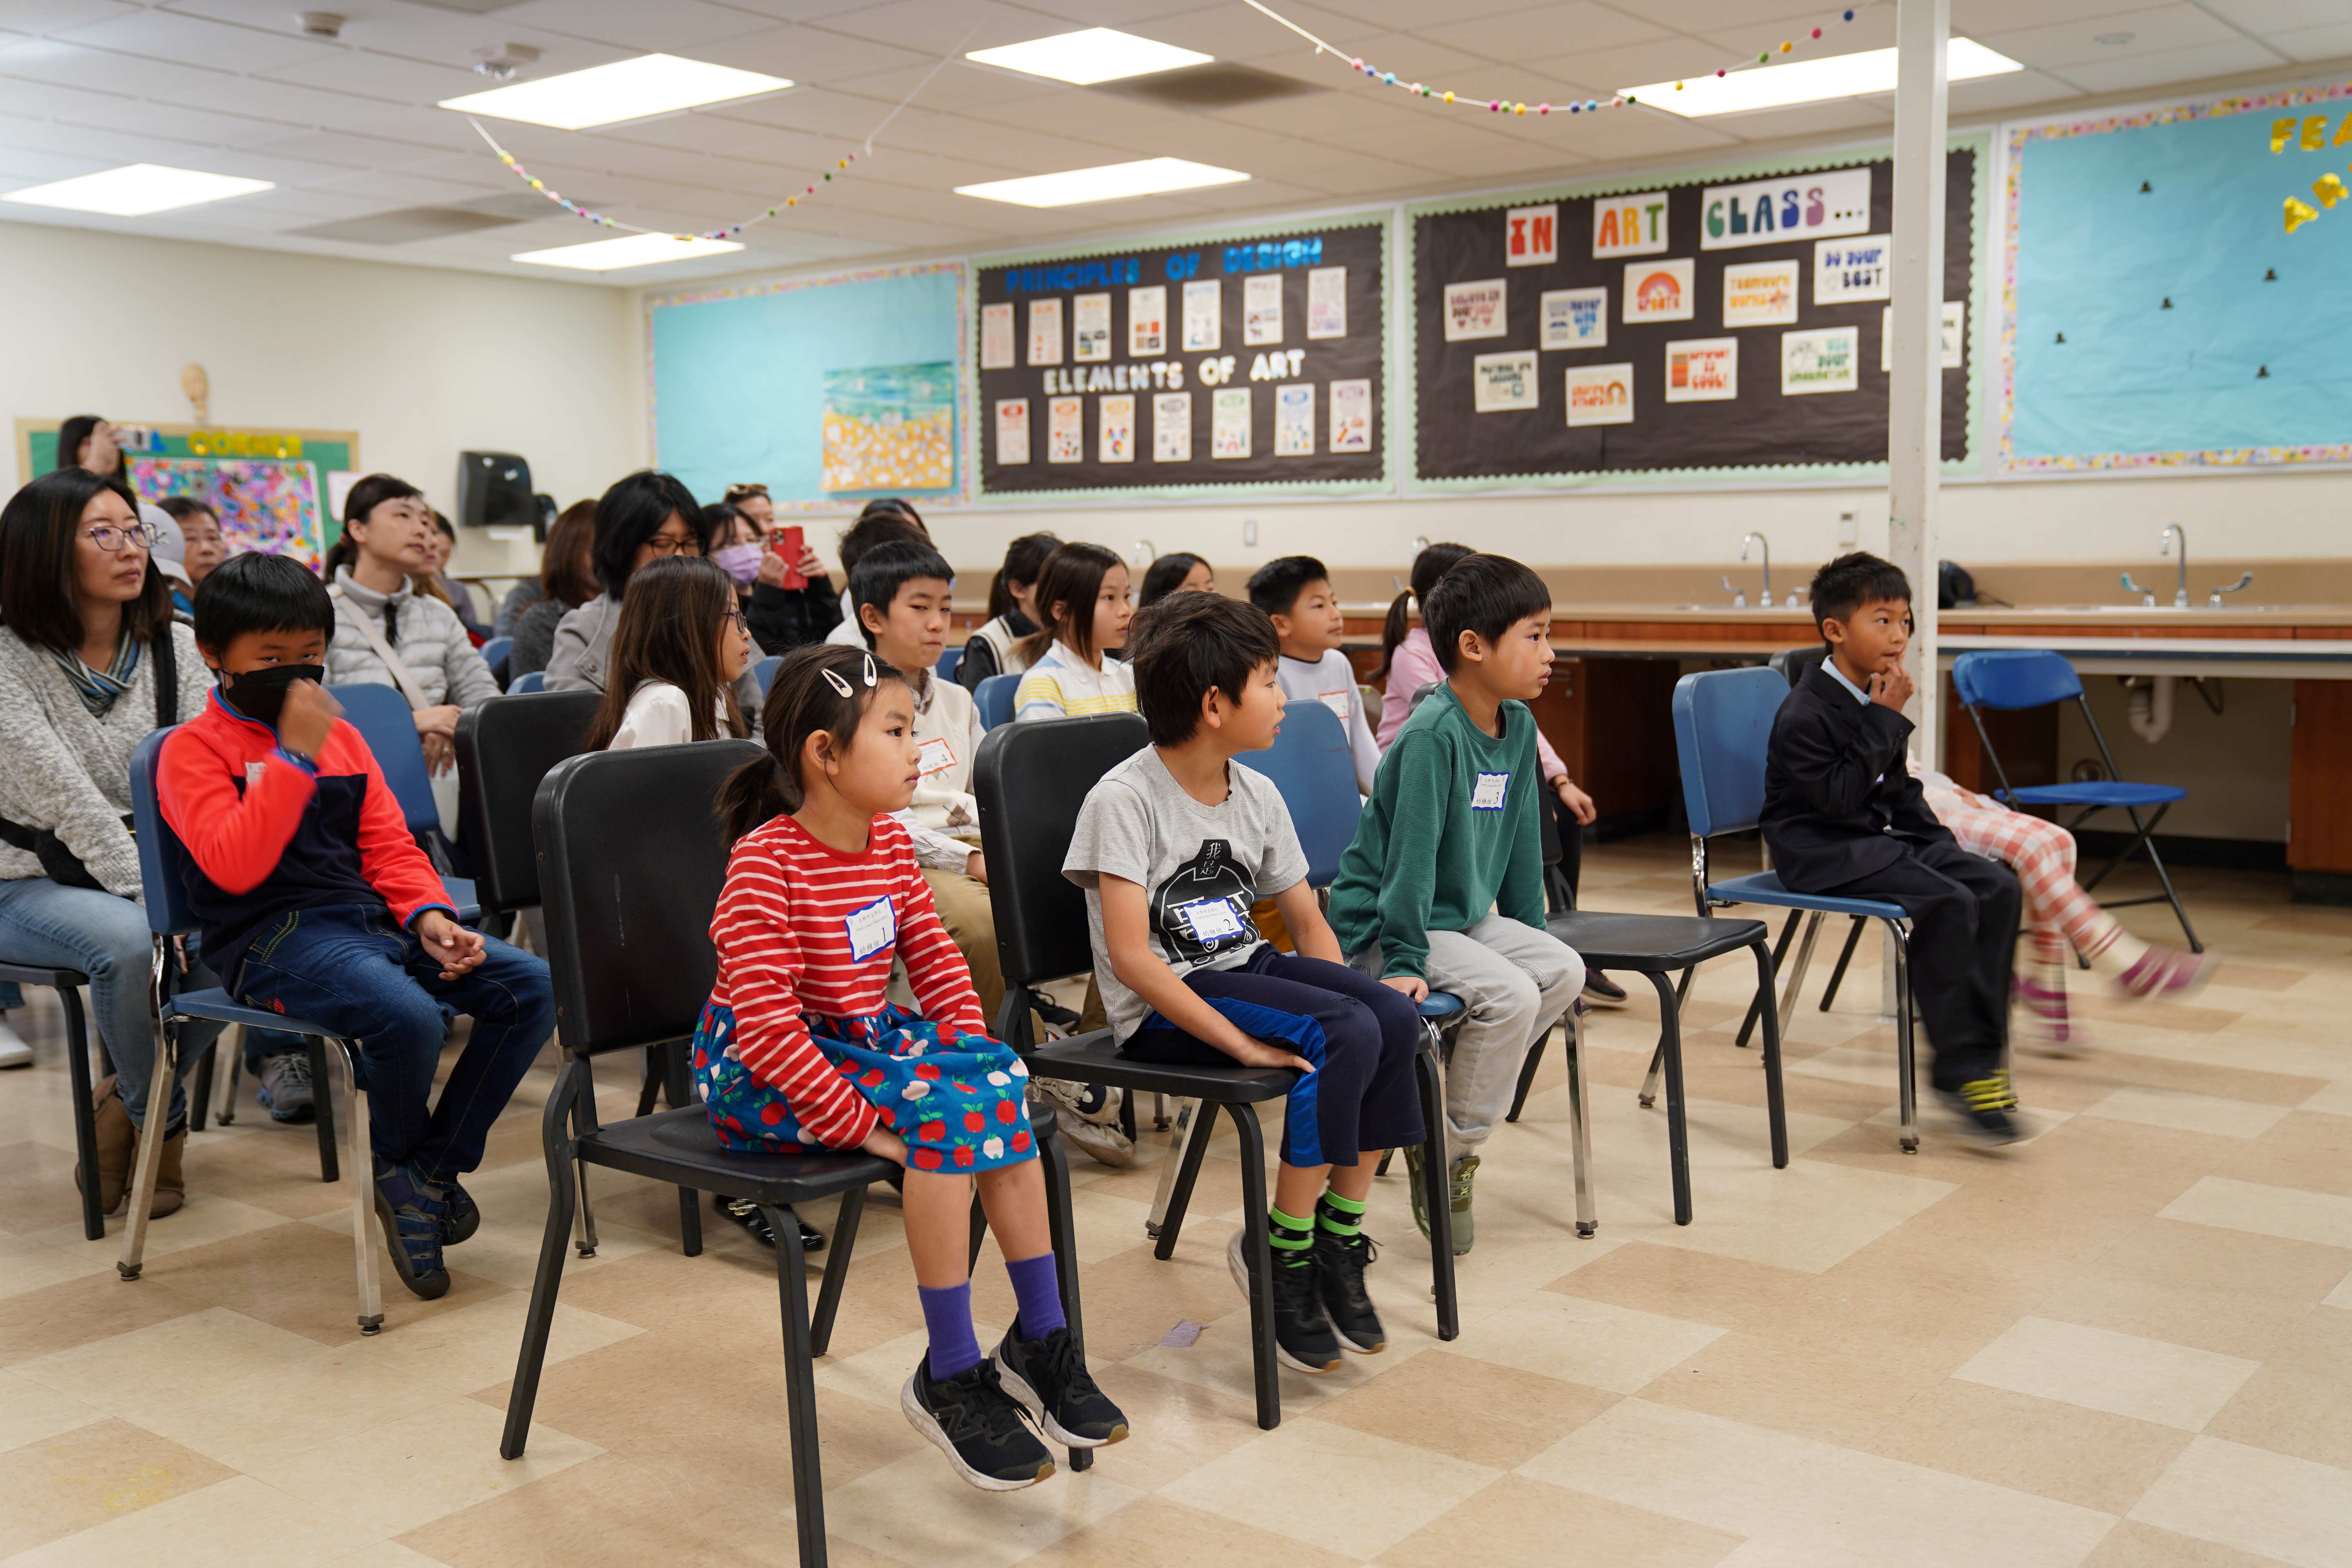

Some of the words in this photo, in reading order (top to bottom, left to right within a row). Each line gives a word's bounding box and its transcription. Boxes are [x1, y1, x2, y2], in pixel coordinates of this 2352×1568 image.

[1510, 216, 1552, 256] IN
[1598, 203, 1664, 248] ART
[1005, 258, 1140, 294] PRINCIPLES
[1165, 252, 1201, 281] OF
[1223, 236, 1323, 273] DESIGN
[1043, 361, 1183, 394] ELEMENTS
[1199, 356, 1236, 386] OF
[1250, 349, 1305, 382] ART
[188, 430, 302, 459] CORNER
[942, 754, 949, 762] 4
[1494, 792, 1499, 804] 3
[1200, 842, 1222, 875] 我是
[882, 927, 886, 942] 1
[1223, 919, 1234, 931] 2
